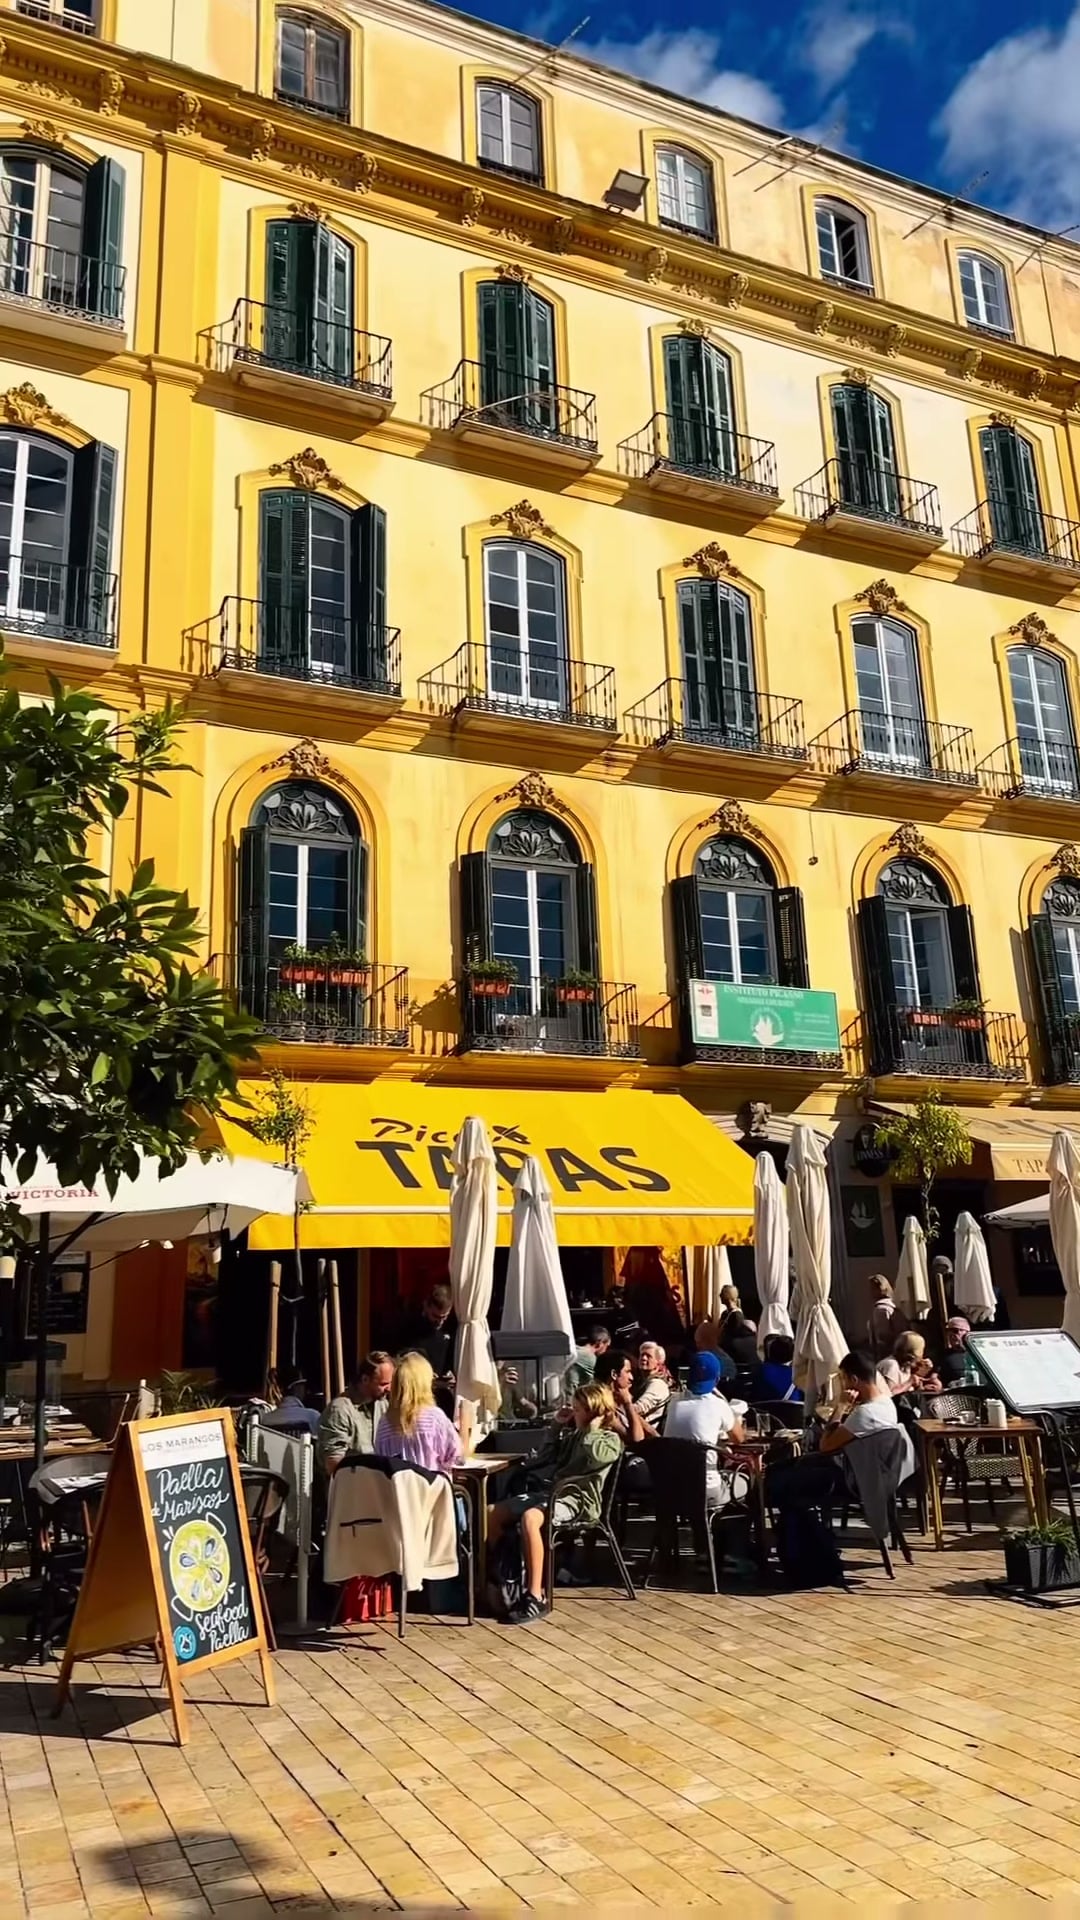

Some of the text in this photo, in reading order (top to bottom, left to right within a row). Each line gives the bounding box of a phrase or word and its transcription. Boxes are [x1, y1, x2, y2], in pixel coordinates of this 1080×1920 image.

[1012, 1159, 1049, 1173] TAP
[10, 1189, 99, 1200] VICTORIA
[166, 1432, 222, 1448] MARANGOS
[156, 1462, 224, 1505] Paella
[195, 1585, 249, 1640] Seafood
[209, 1620, 249, 1653] Paella
